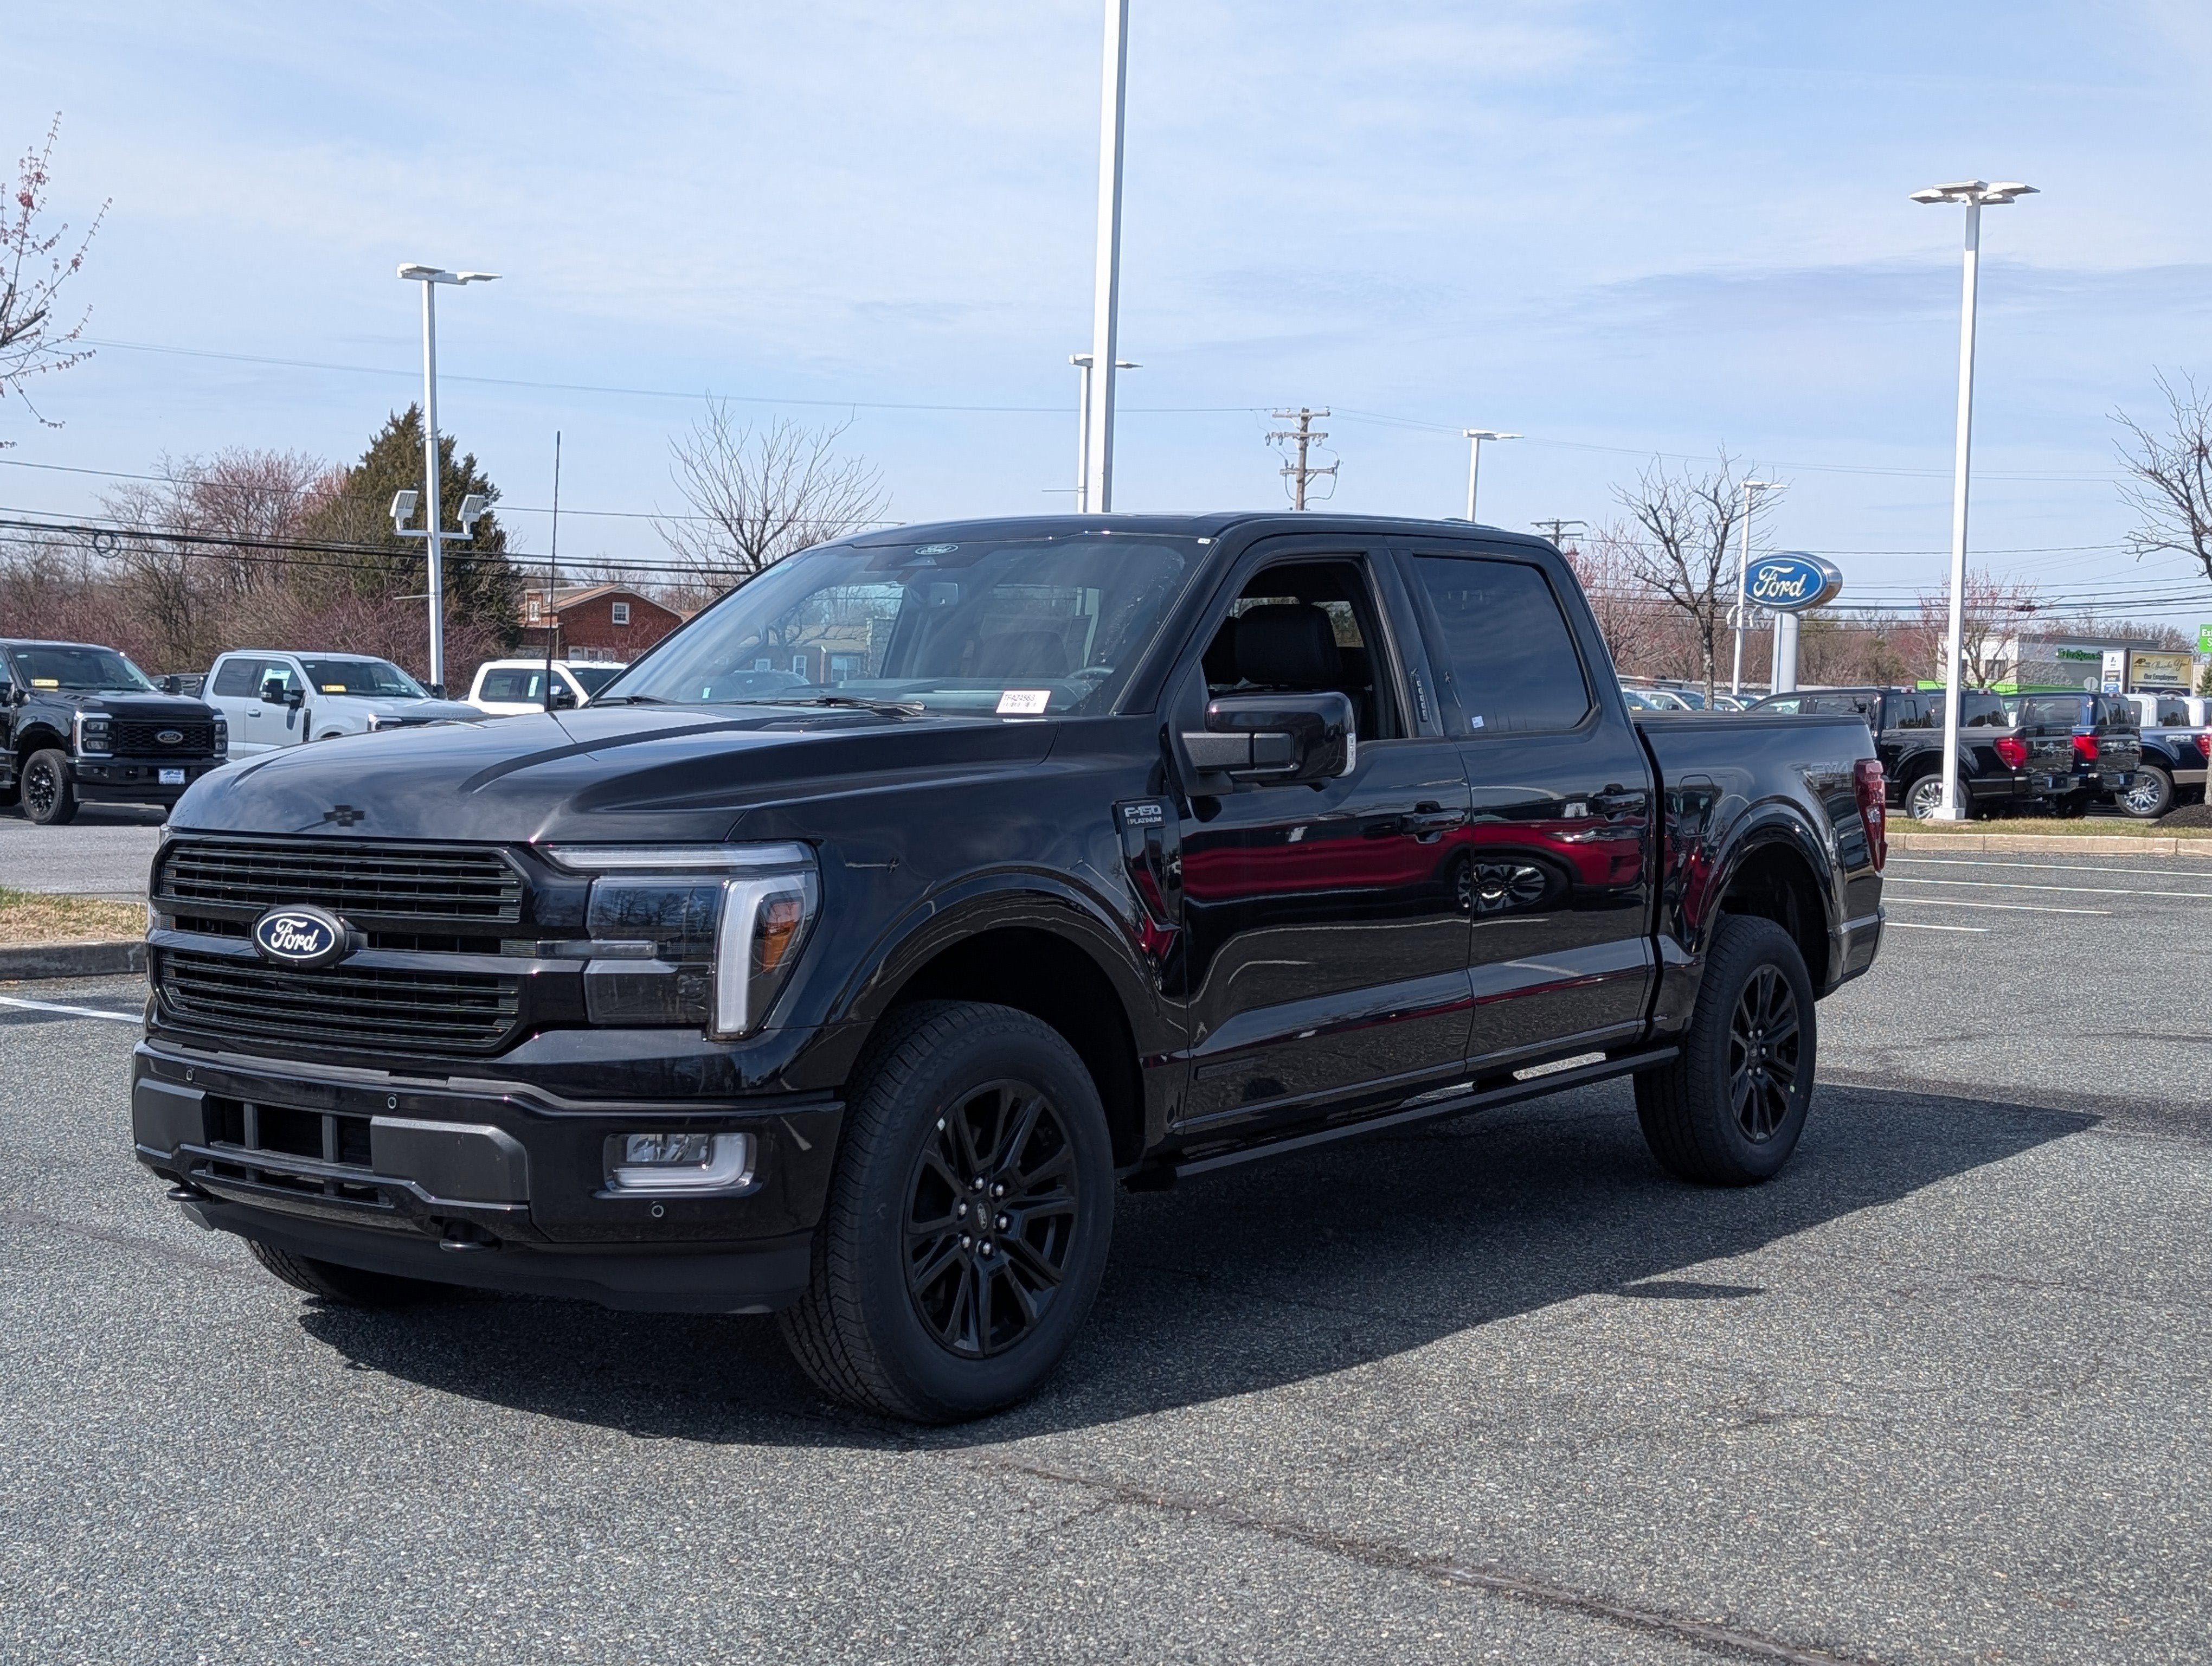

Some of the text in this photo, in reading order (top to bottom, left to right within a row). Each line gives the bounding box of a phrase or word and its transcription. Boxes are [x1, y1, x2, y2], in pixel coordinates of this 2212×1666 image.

[1753, 566, 1807, 597] Ford
[1124, 805, 1162, 817] F-150
[1129, 816, 1162, 824] PLATINUM
[271, 918, 319, 951] Ford
